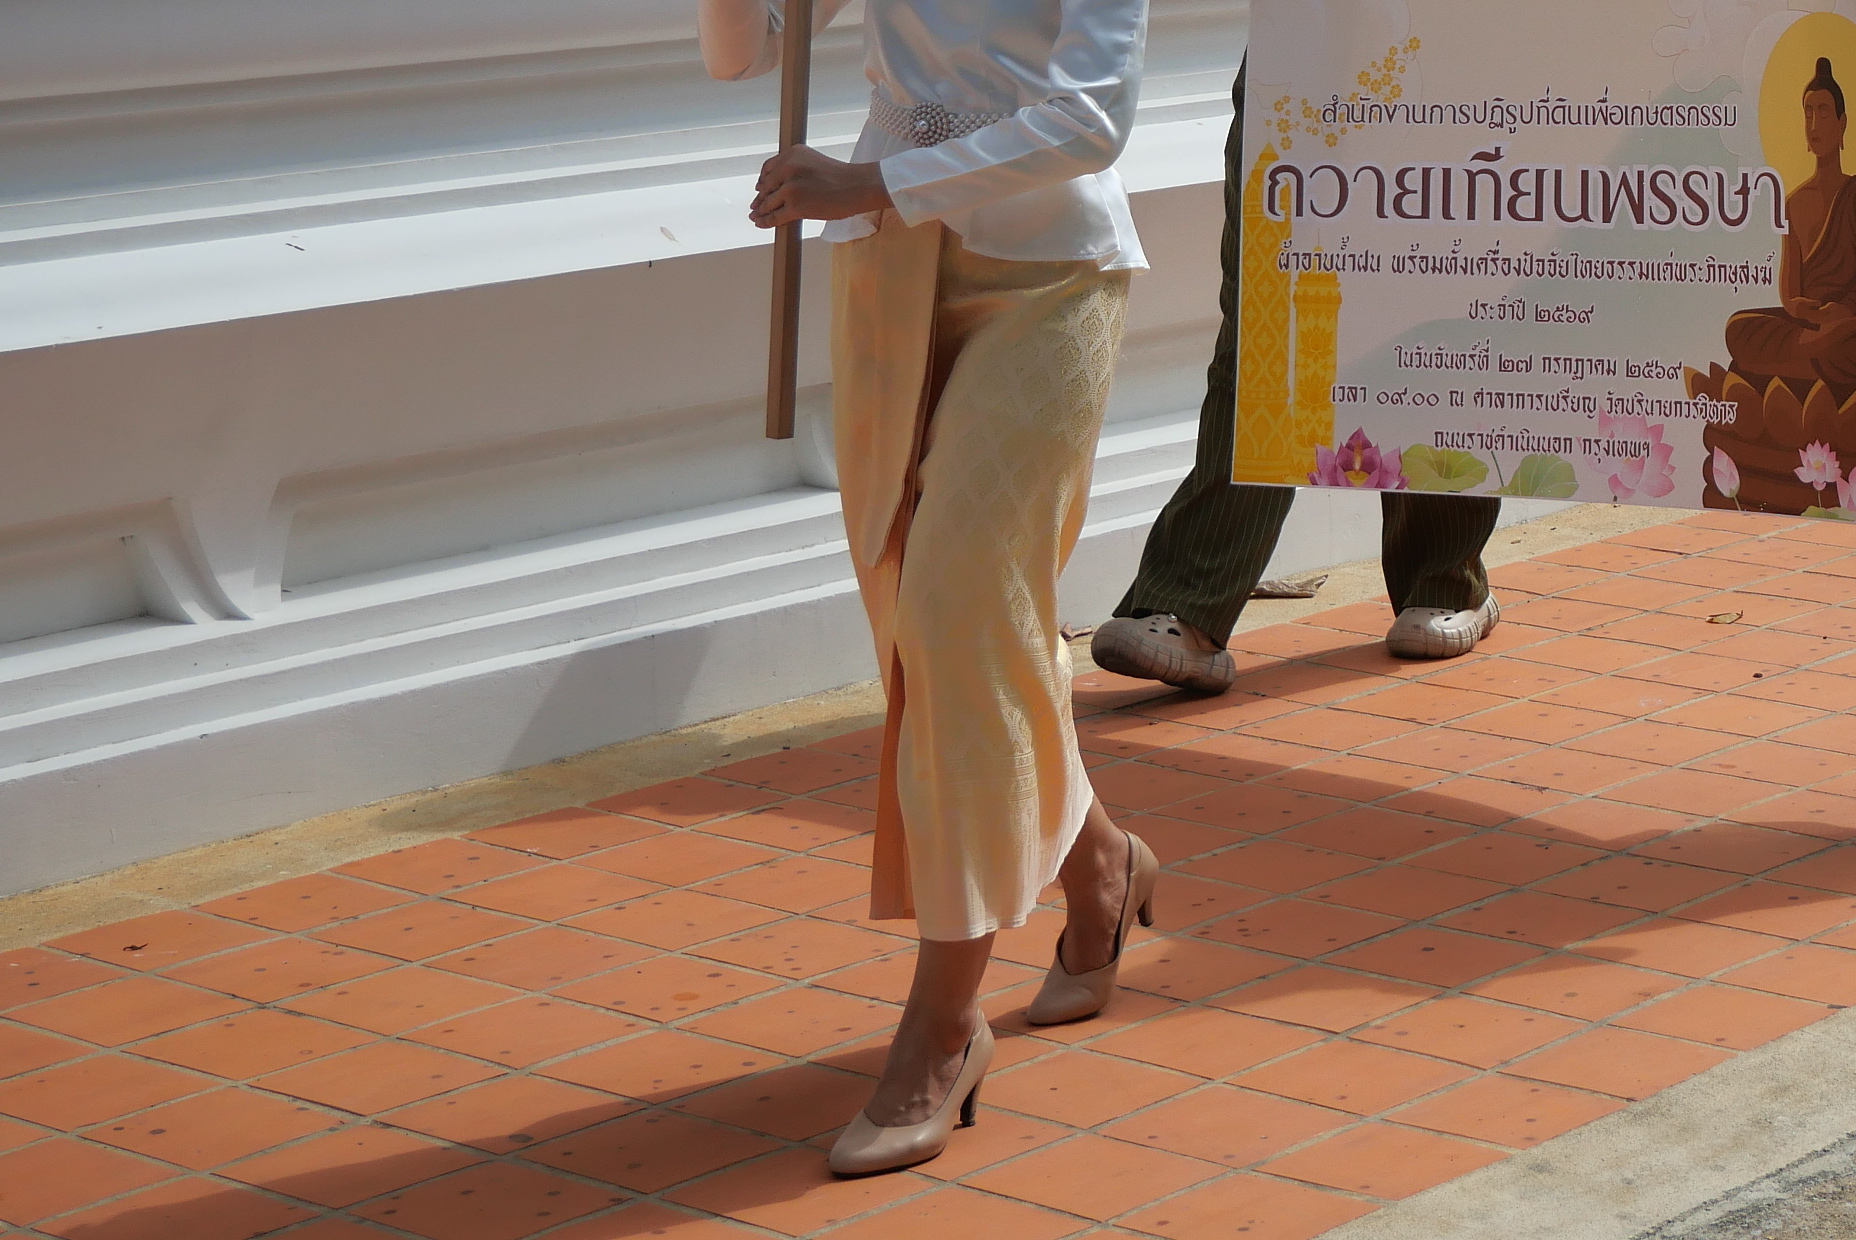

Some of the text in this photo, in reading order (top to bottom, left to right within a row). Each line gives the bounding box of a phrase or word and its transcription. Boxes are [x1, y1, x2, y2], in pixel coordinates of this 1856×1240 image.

[1321, 86, 1738, 135] สำนักงานการปฏิรูปที่ดินเพื่อเกษตรกรรม
[1266, 146, 1788, 230] ถวายเทียนพรรษา
[1278, 236, 1381, 274] ผ้าอาบน้ำฝน
[1468, 295, 1595, 325] ประจำปี ๒๕๖๙
[1394, 338, 1683, 381] ในวันจันทร์ที่ ๒๗ กรกฎาคม ๒๕๖๙
[1331, 385, 1738, 423] เวลา ๐๙.๐๐ ณ ศาลาการเปรียญ วัดปรินายกวรวิหาร
[1433, 426, 1651, 464] ถนนราชดำเนินนอก กรุงเทพฯ
